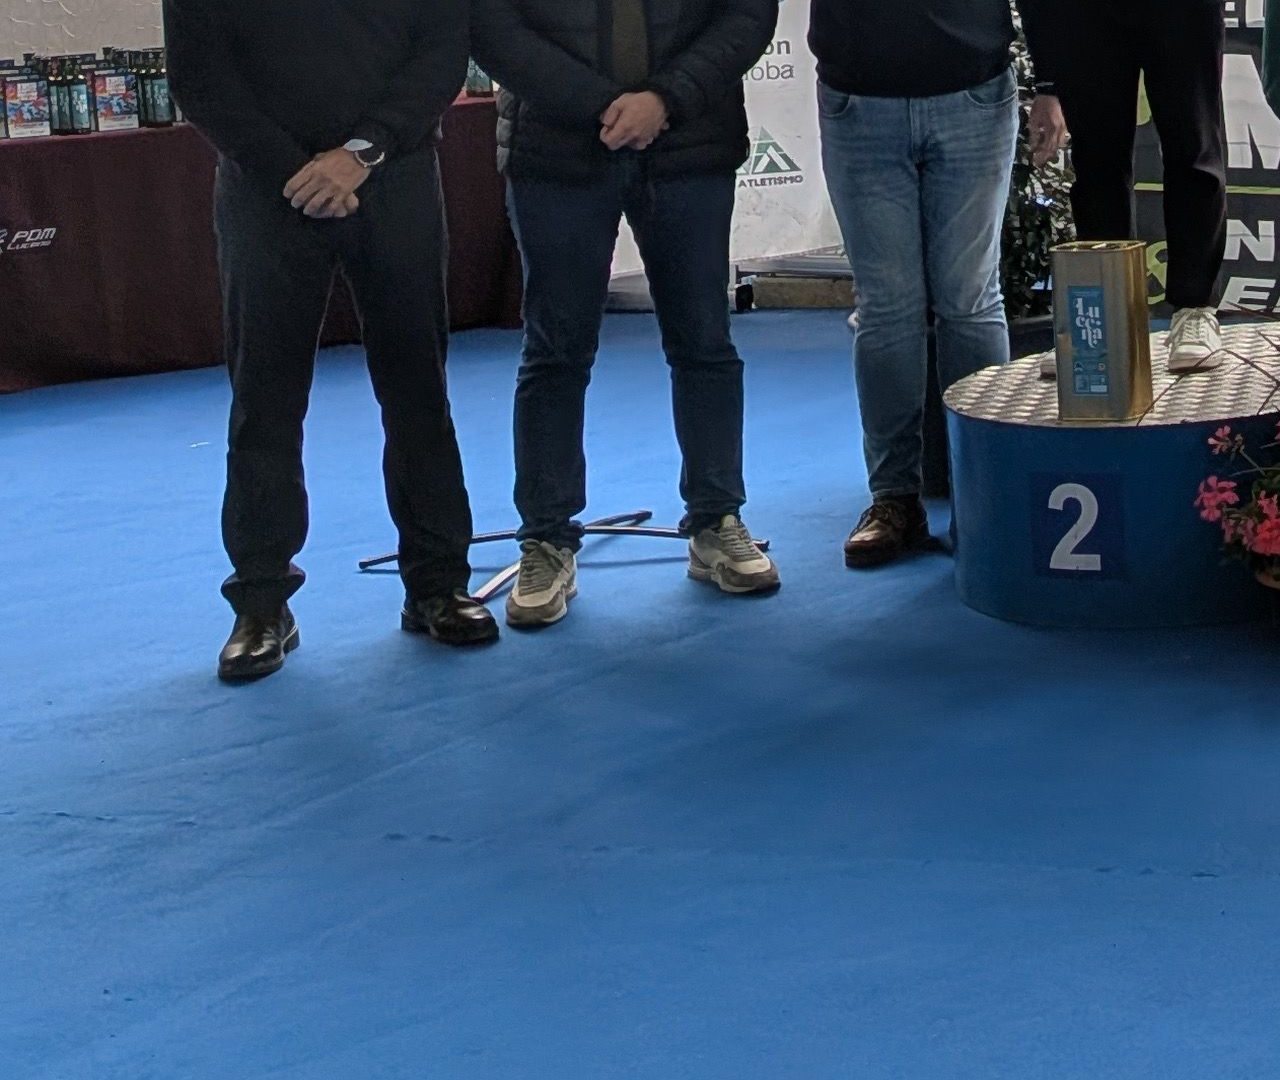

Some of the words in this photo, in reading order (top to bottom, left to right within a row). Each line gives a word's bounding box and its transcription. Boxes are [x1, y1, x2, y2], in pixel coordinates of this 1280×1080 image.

[738, 174, 804, 188] ATLETISMO
[12, 227, 57, 243] PDM
[1047, 482, 1102, 571] 2
